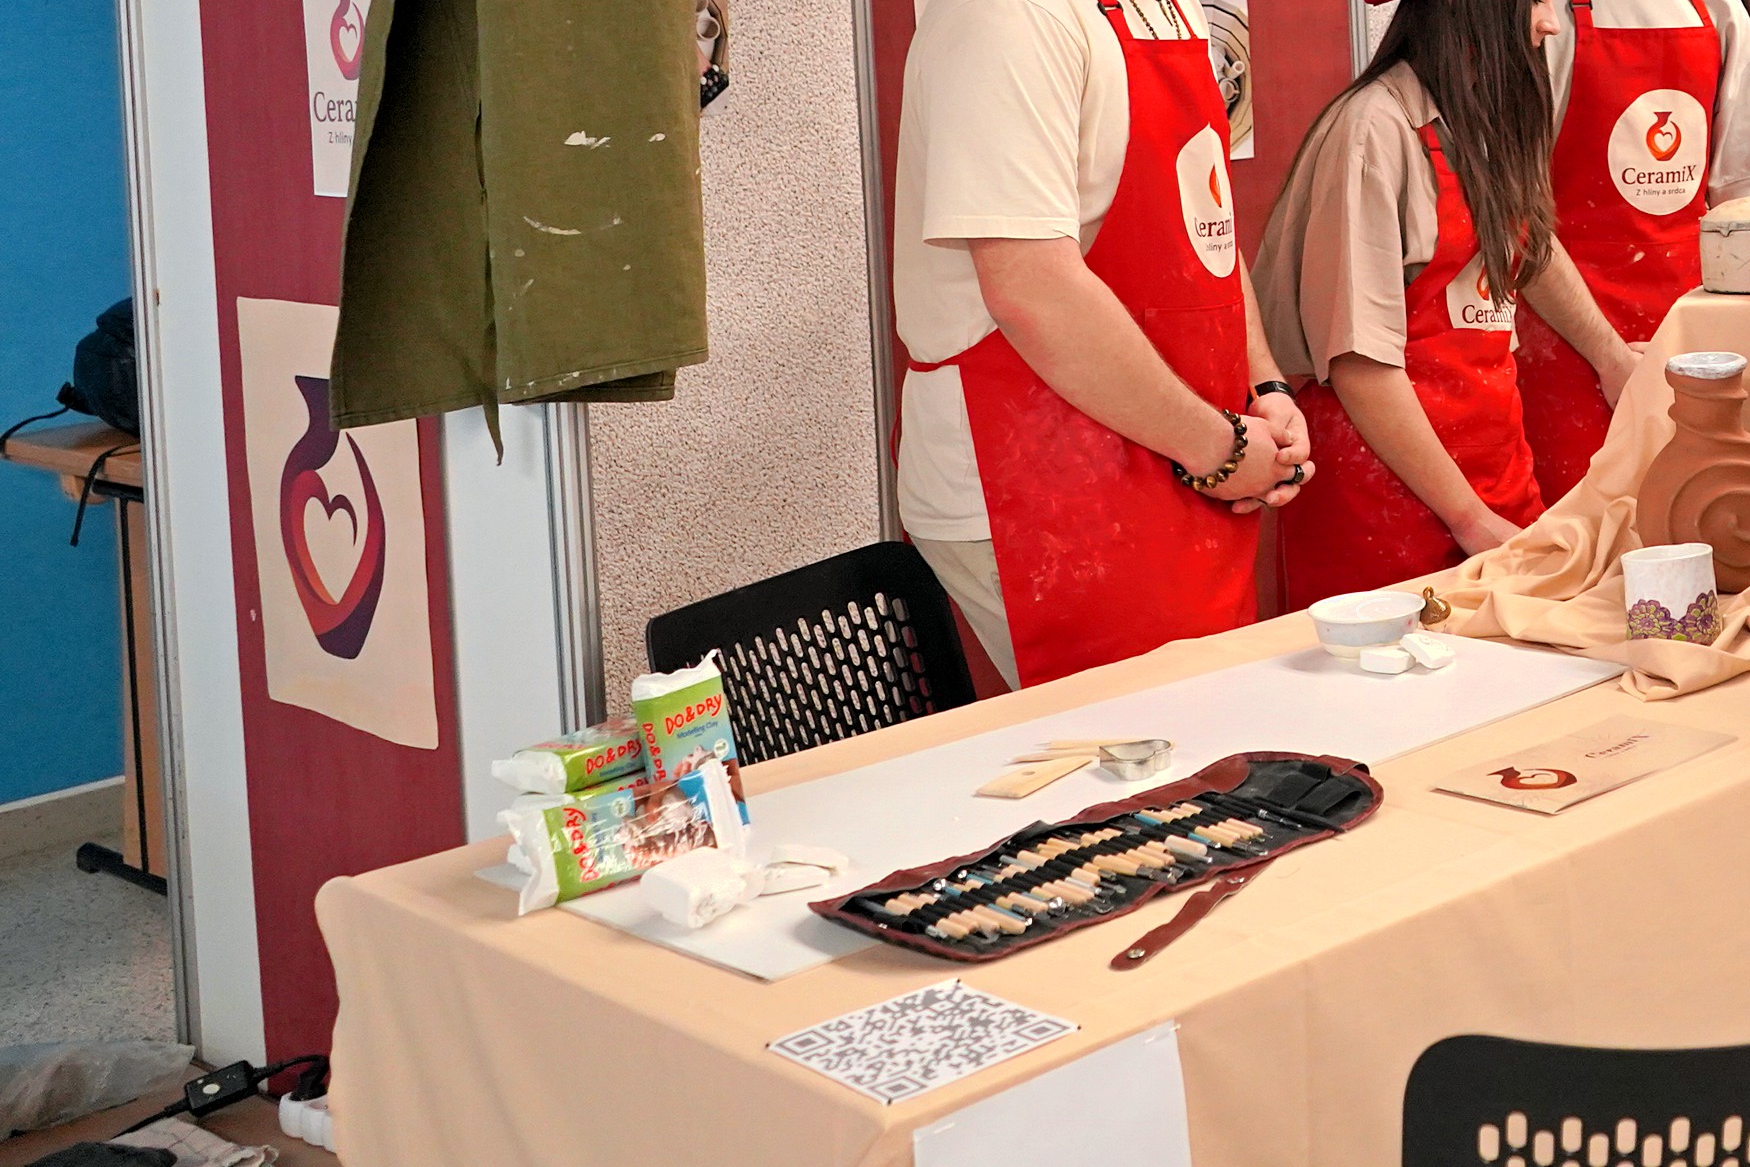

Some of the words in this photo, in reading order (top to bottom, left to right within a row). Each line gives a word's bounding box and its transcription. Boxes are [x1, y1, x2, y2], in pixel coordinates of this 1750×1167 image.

[313, 91, 357, 123] Cera
[1621, 164, 1697, 185] CeramiX
[665, 693, 722, 735] DO&DRY
